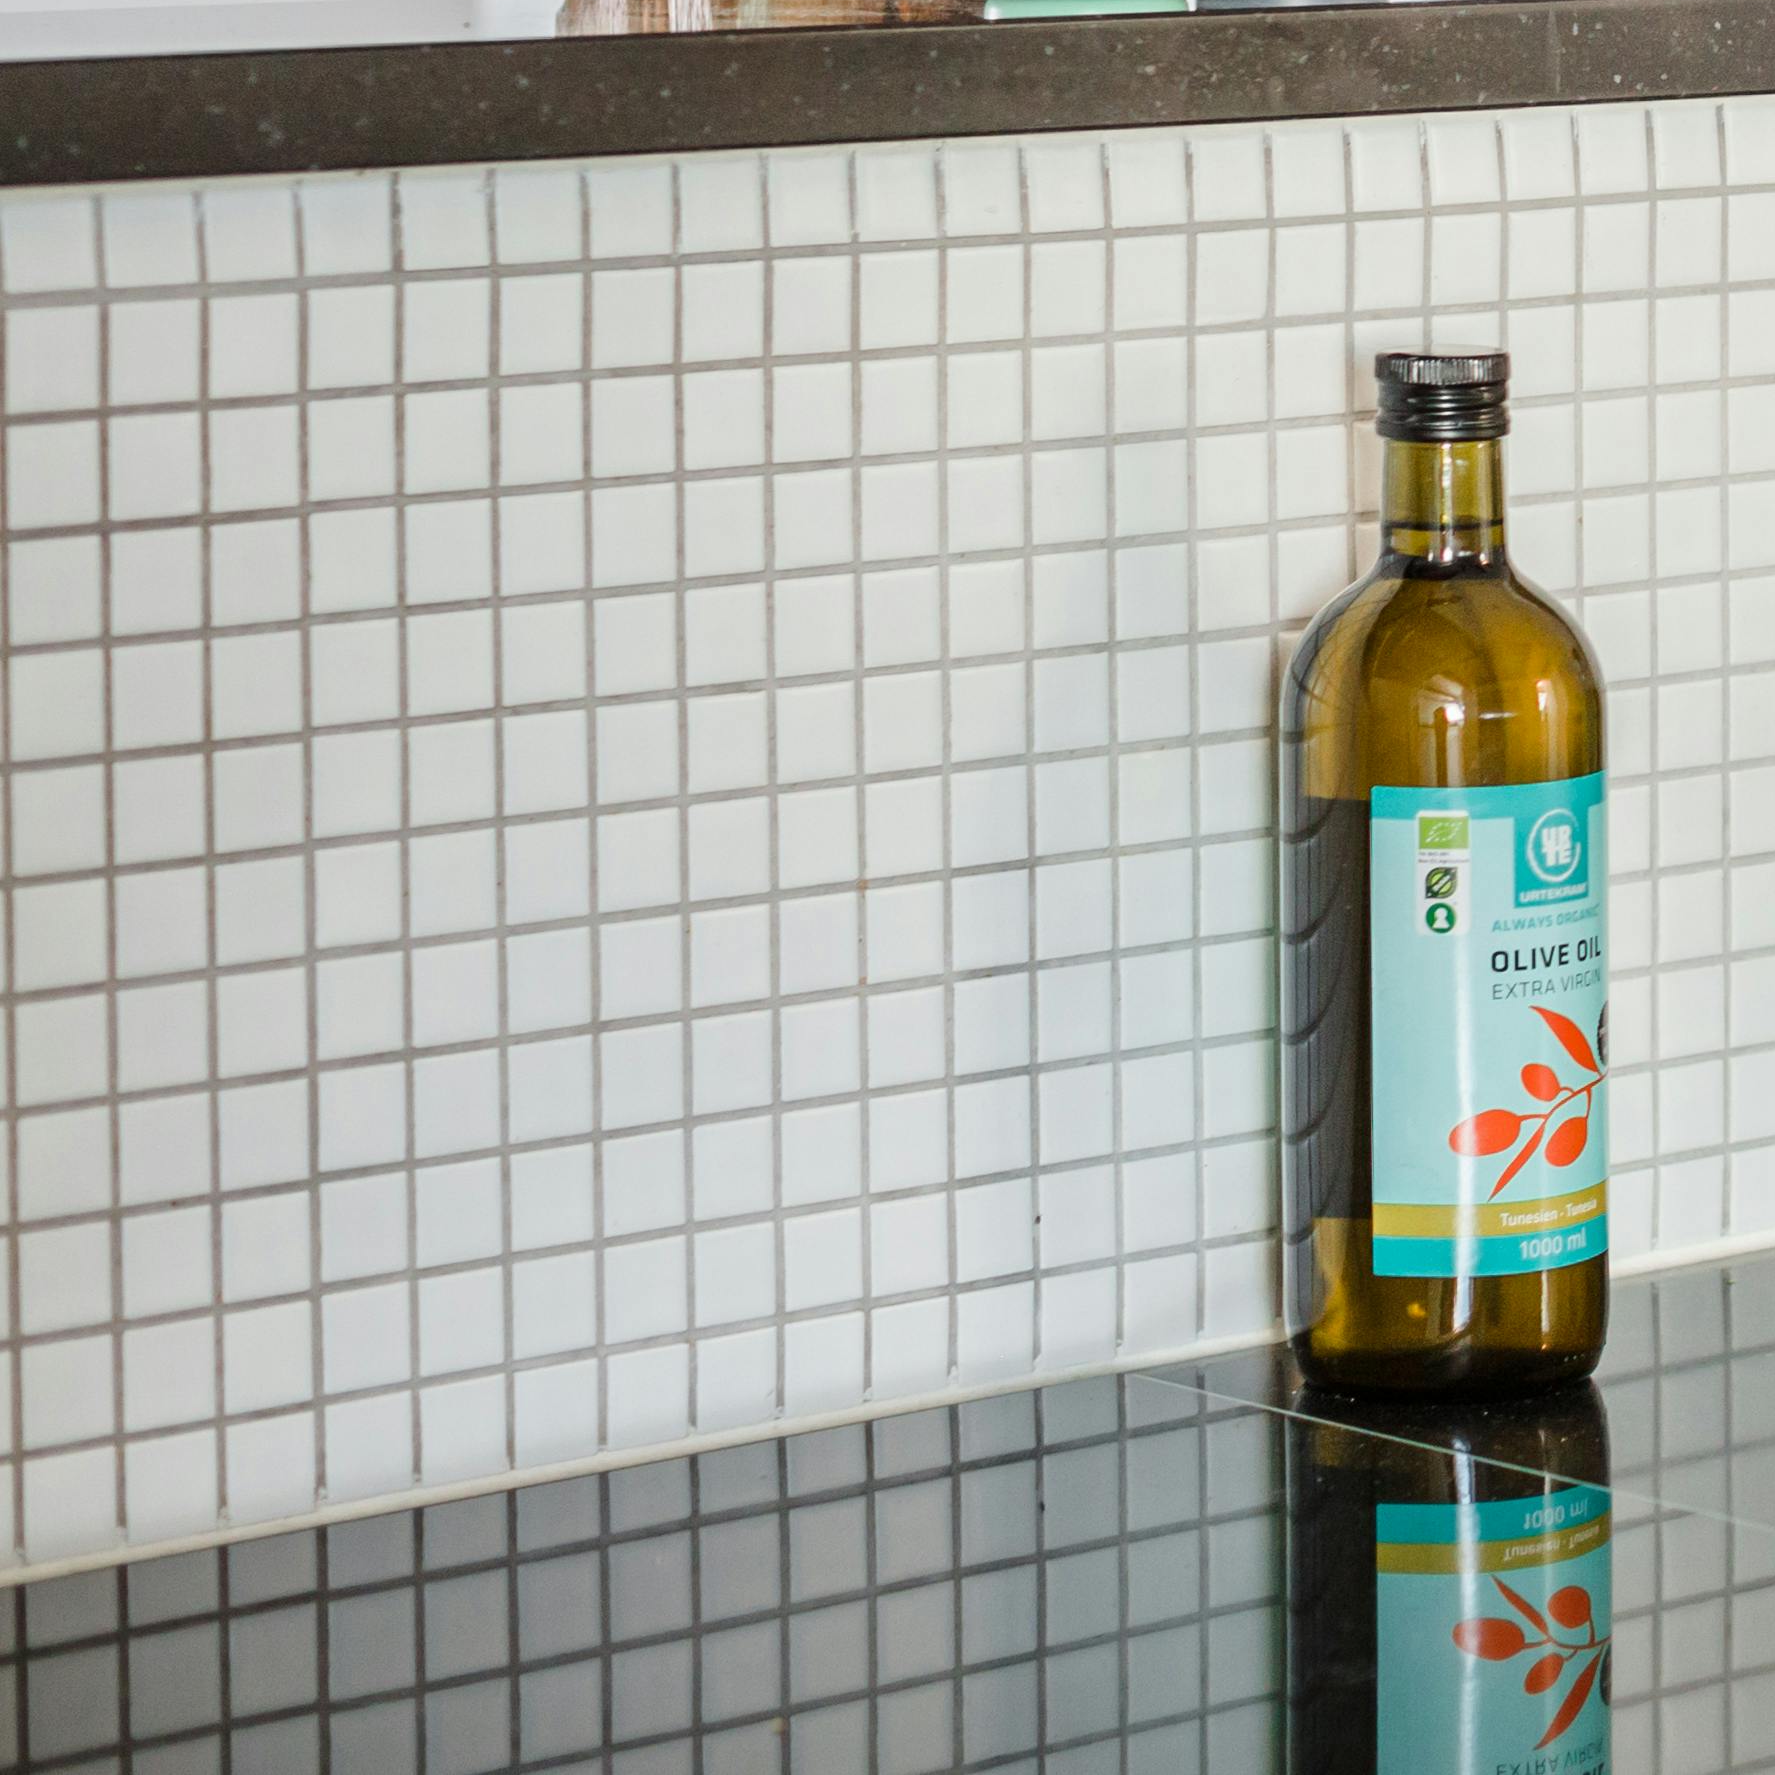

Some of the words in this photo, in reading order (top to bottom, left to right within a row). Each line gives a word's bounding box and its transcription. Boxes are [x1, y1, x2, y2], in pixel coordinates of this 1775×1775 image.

[1492, 914, 1553, 932] ALWAYS
[1491, 943, 1570, 973] OLIVE
[1577, 935, 1601, 962] OIL
[1492, 979, 1557, 1000] EXTRA
[1560, 968, 1601, 992] VIRGIN
[1500, 1208, 1558, 1227] Tunesien
[1519, 1234, 1563, 1260] 1000
[1567, 1225, 1587, 1251] ml
